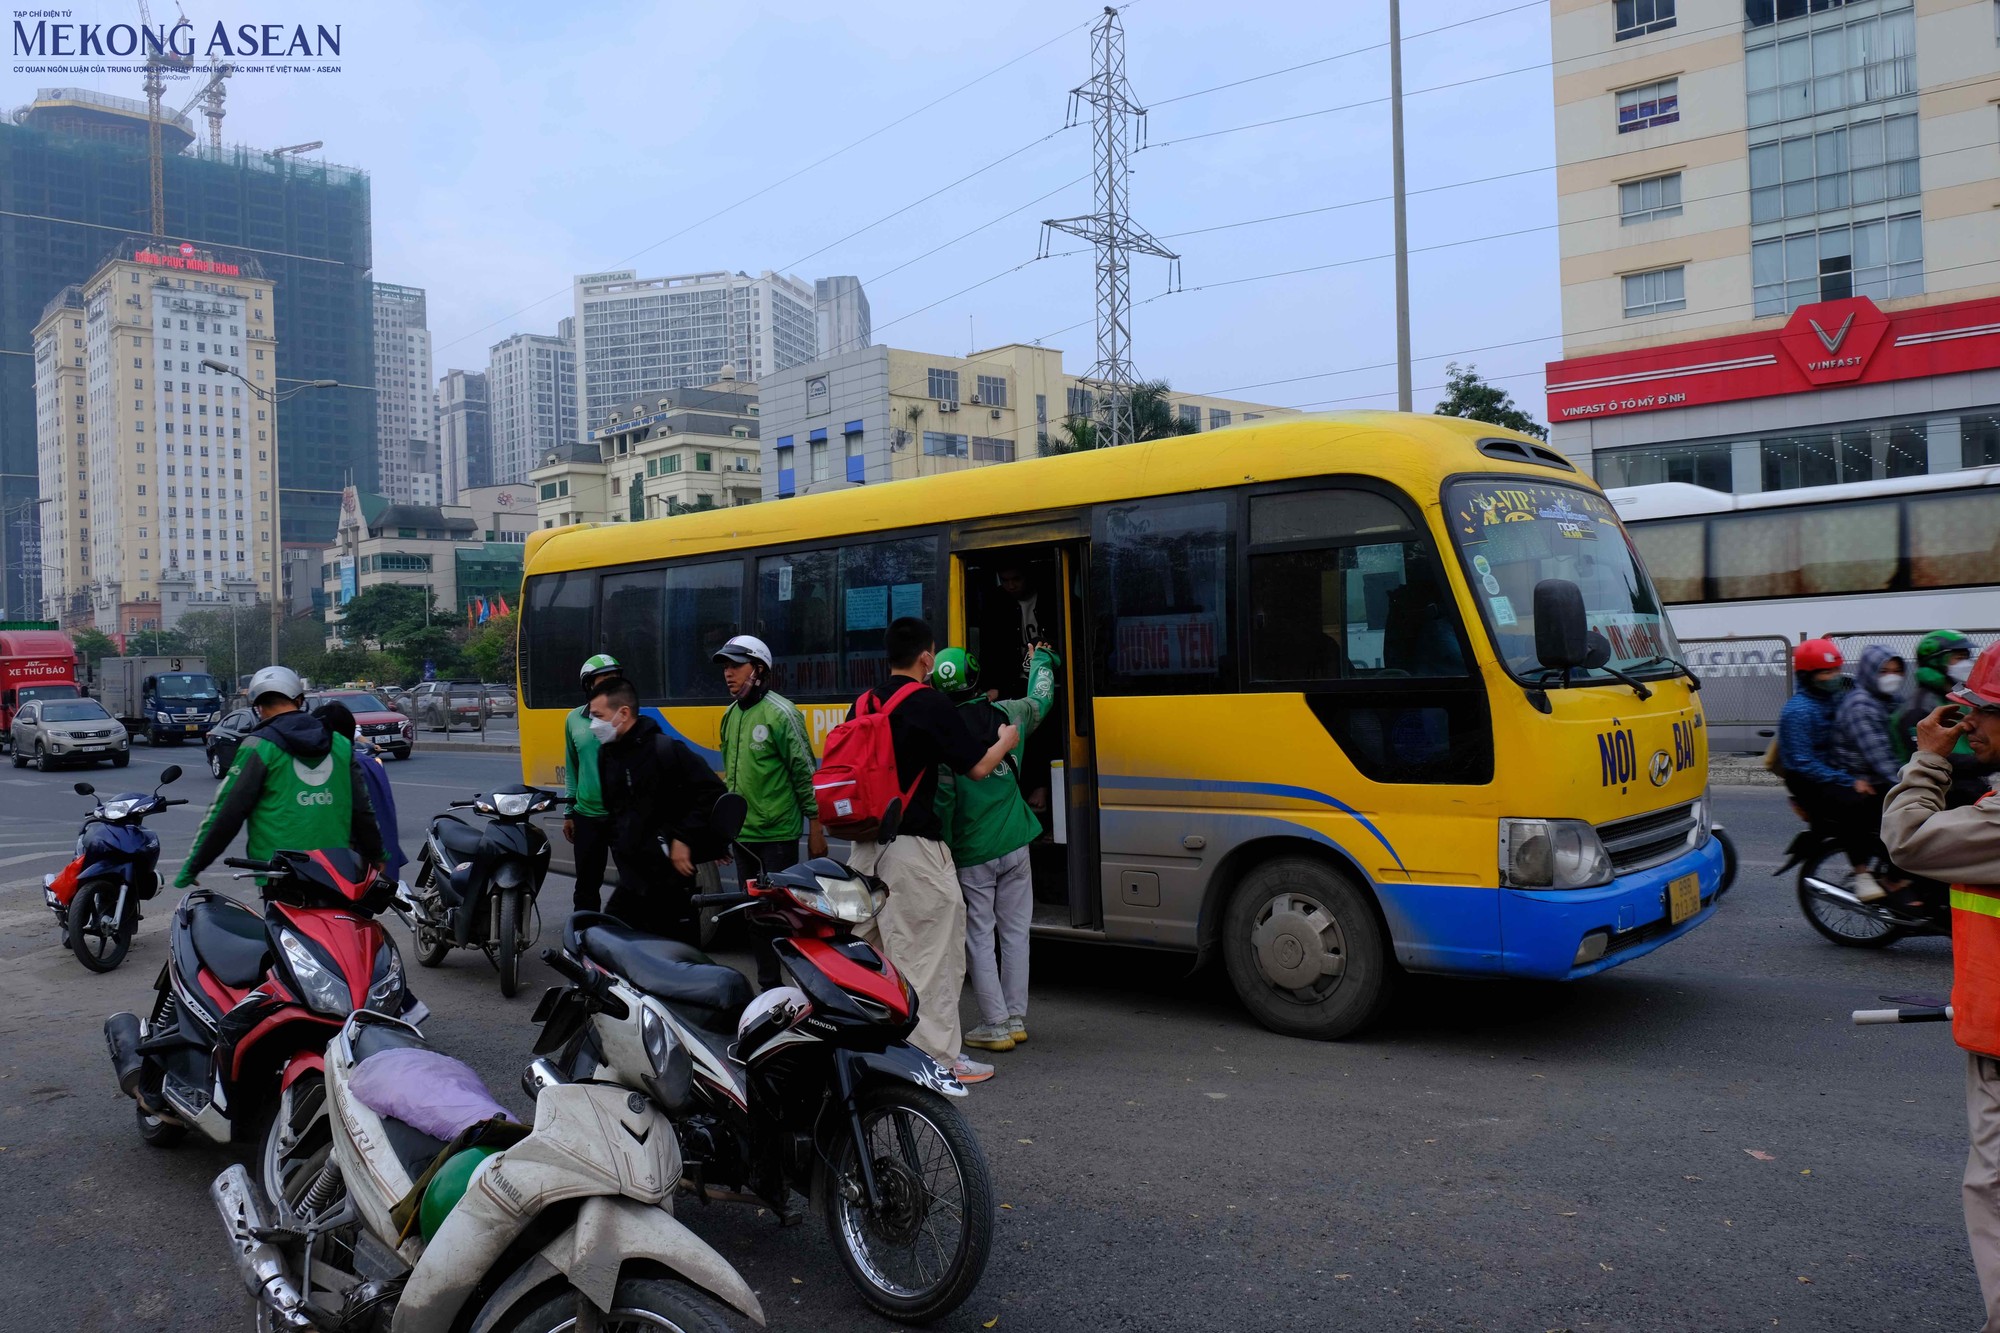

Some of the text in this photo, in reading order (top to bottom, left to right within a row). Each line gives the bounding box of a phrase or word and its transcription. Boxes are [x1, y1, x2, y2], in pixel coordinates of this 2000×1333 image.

[186, 259, 209, 271] MINH
[1808, 356, 1862, 371] VINFAST
[1562, 403, 1606, 416] VINFAST
[1608, 400, 1618, 411] Ô
[1621, 398, 1636, 410] TÔ
[1638, 395, 1654, 407] MỸ
[1495, 490, 1529, 511] VIP
[1120, 612, 1217, 671] HƯNG YÊN
[24, 667, 45, 675] THƯ
[46, 665, 66, 675] BÁO
[1597, 711, 1695, 794] NỘI BÀI
[296, 788, 333, 806] Grab
[808, 1017, 838, 1032] HONDA
